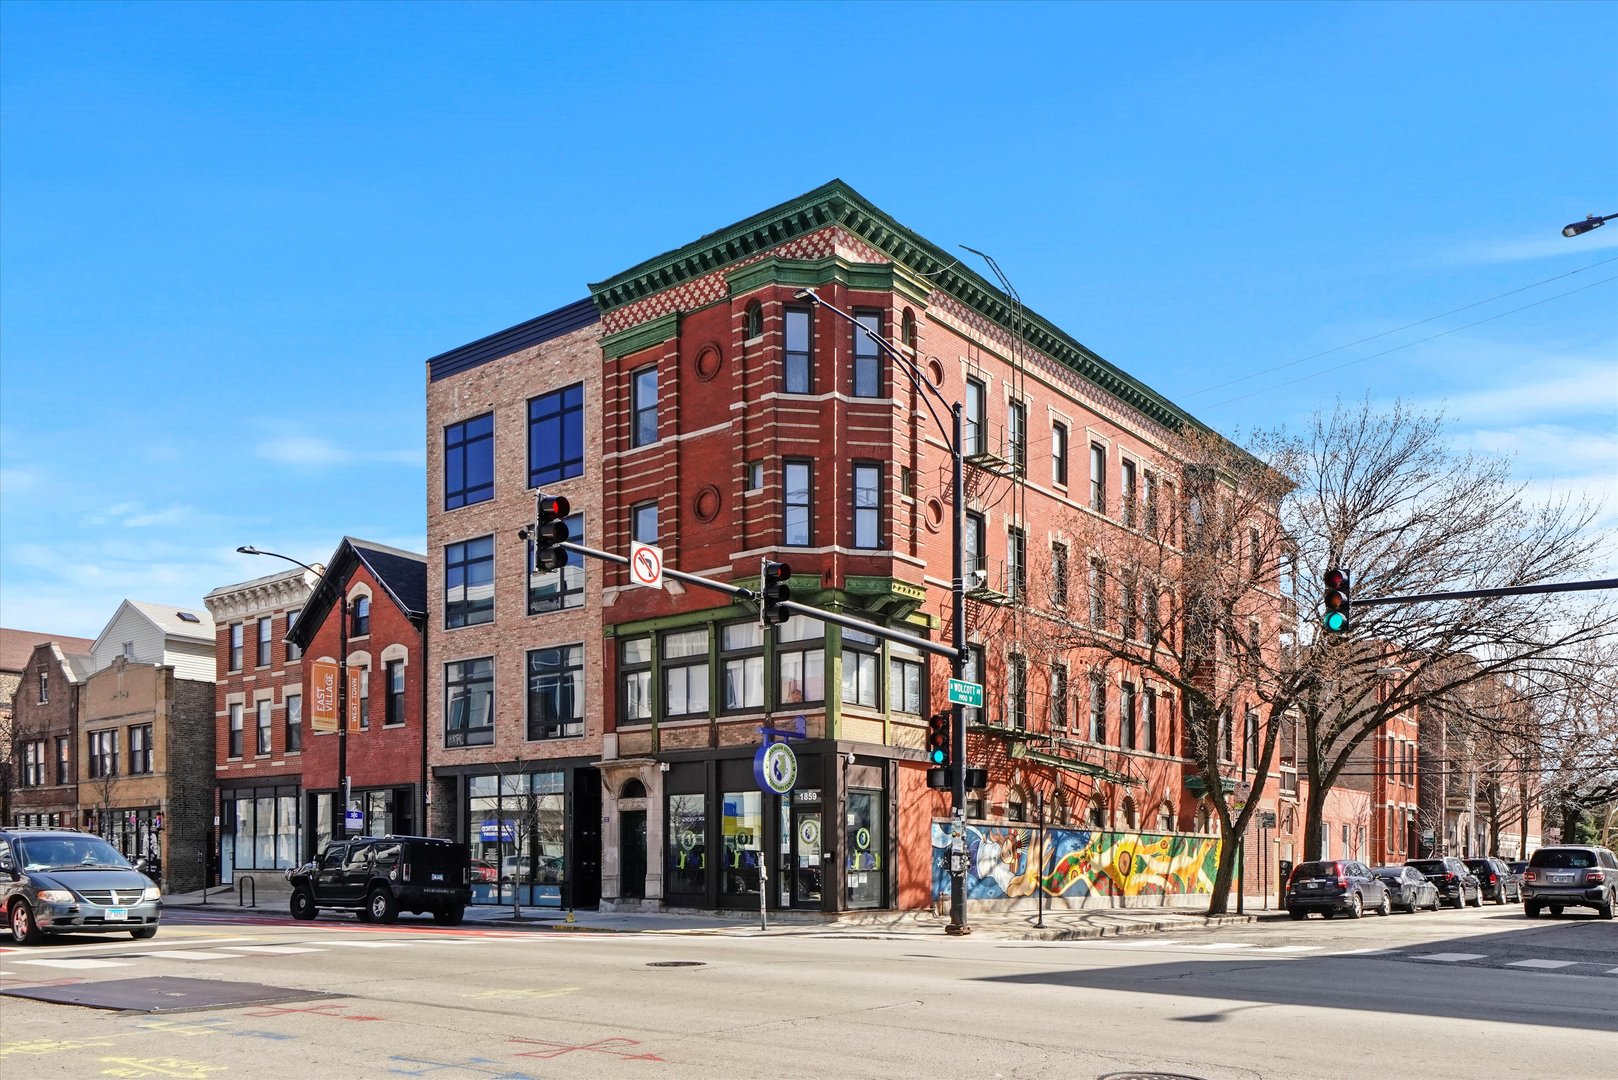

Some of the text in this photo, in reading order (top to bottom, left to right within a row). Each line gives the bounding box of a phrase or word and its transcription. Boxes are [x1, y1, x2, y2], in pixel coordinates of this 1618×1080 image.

[954, 682, 975, 695] WOLCOTT
[317, 687, 325, 711] EAST
[800, 792, 817, 801] 1859
